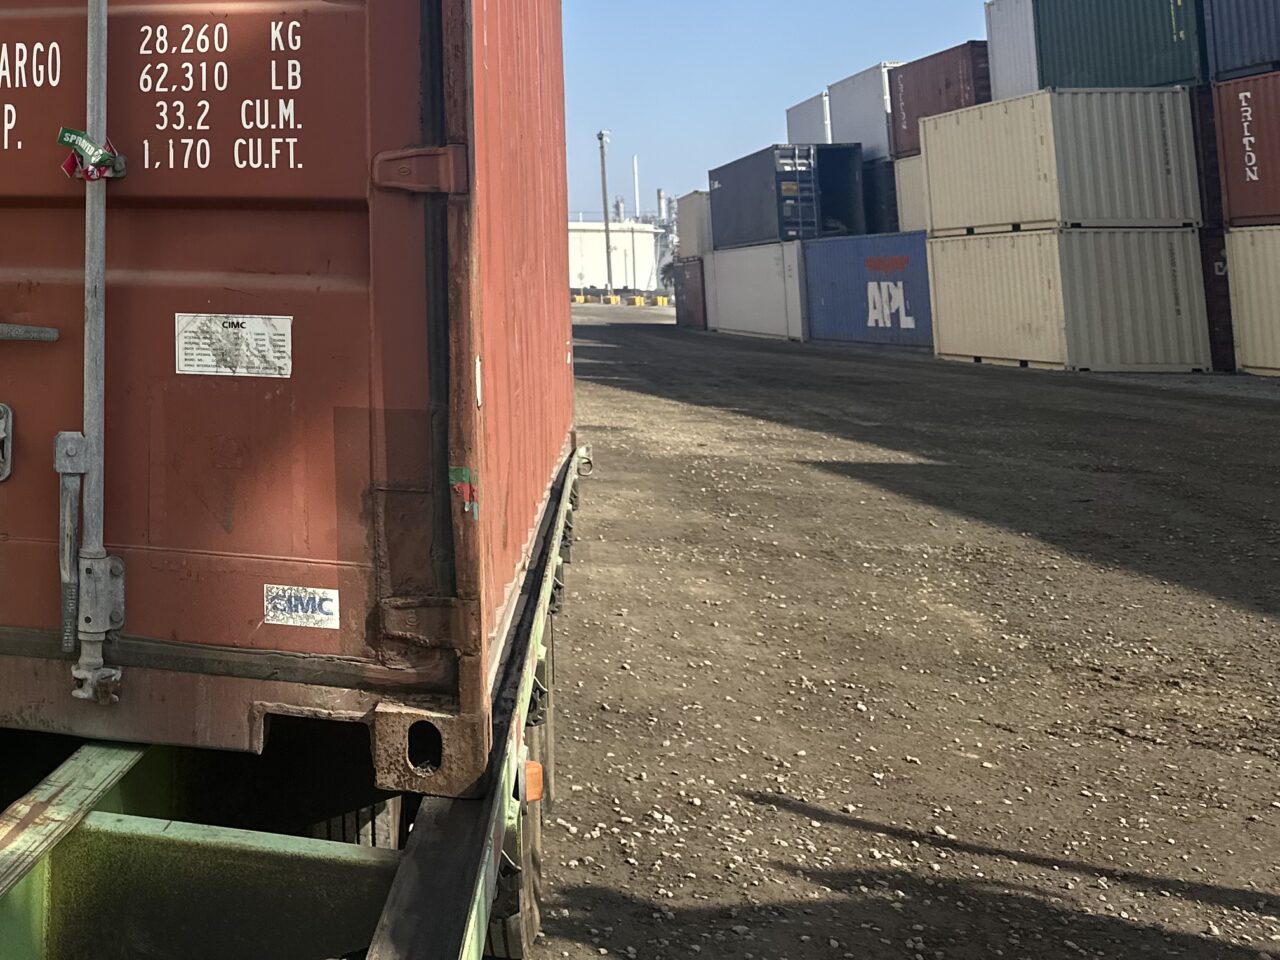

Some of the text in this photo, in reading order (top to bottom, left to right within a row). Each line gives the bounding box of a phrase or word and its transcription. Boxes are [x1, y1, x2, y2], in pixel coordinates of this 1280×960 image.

[139, 21, 302, 56] 28,260 KG
[139, 60, 302, 94] 62,310 LB
[155, 99, 303, 131] 33.2 CU.M.
[63, 132, 95, 156] SPRAYED
[1238, 92, 1259, 181] TRITON
[142, 138, 304, 170] 1,170 CU.FT.
[867, 281, 915, 329] APL
[222, 321, 247, 329] CIMC
